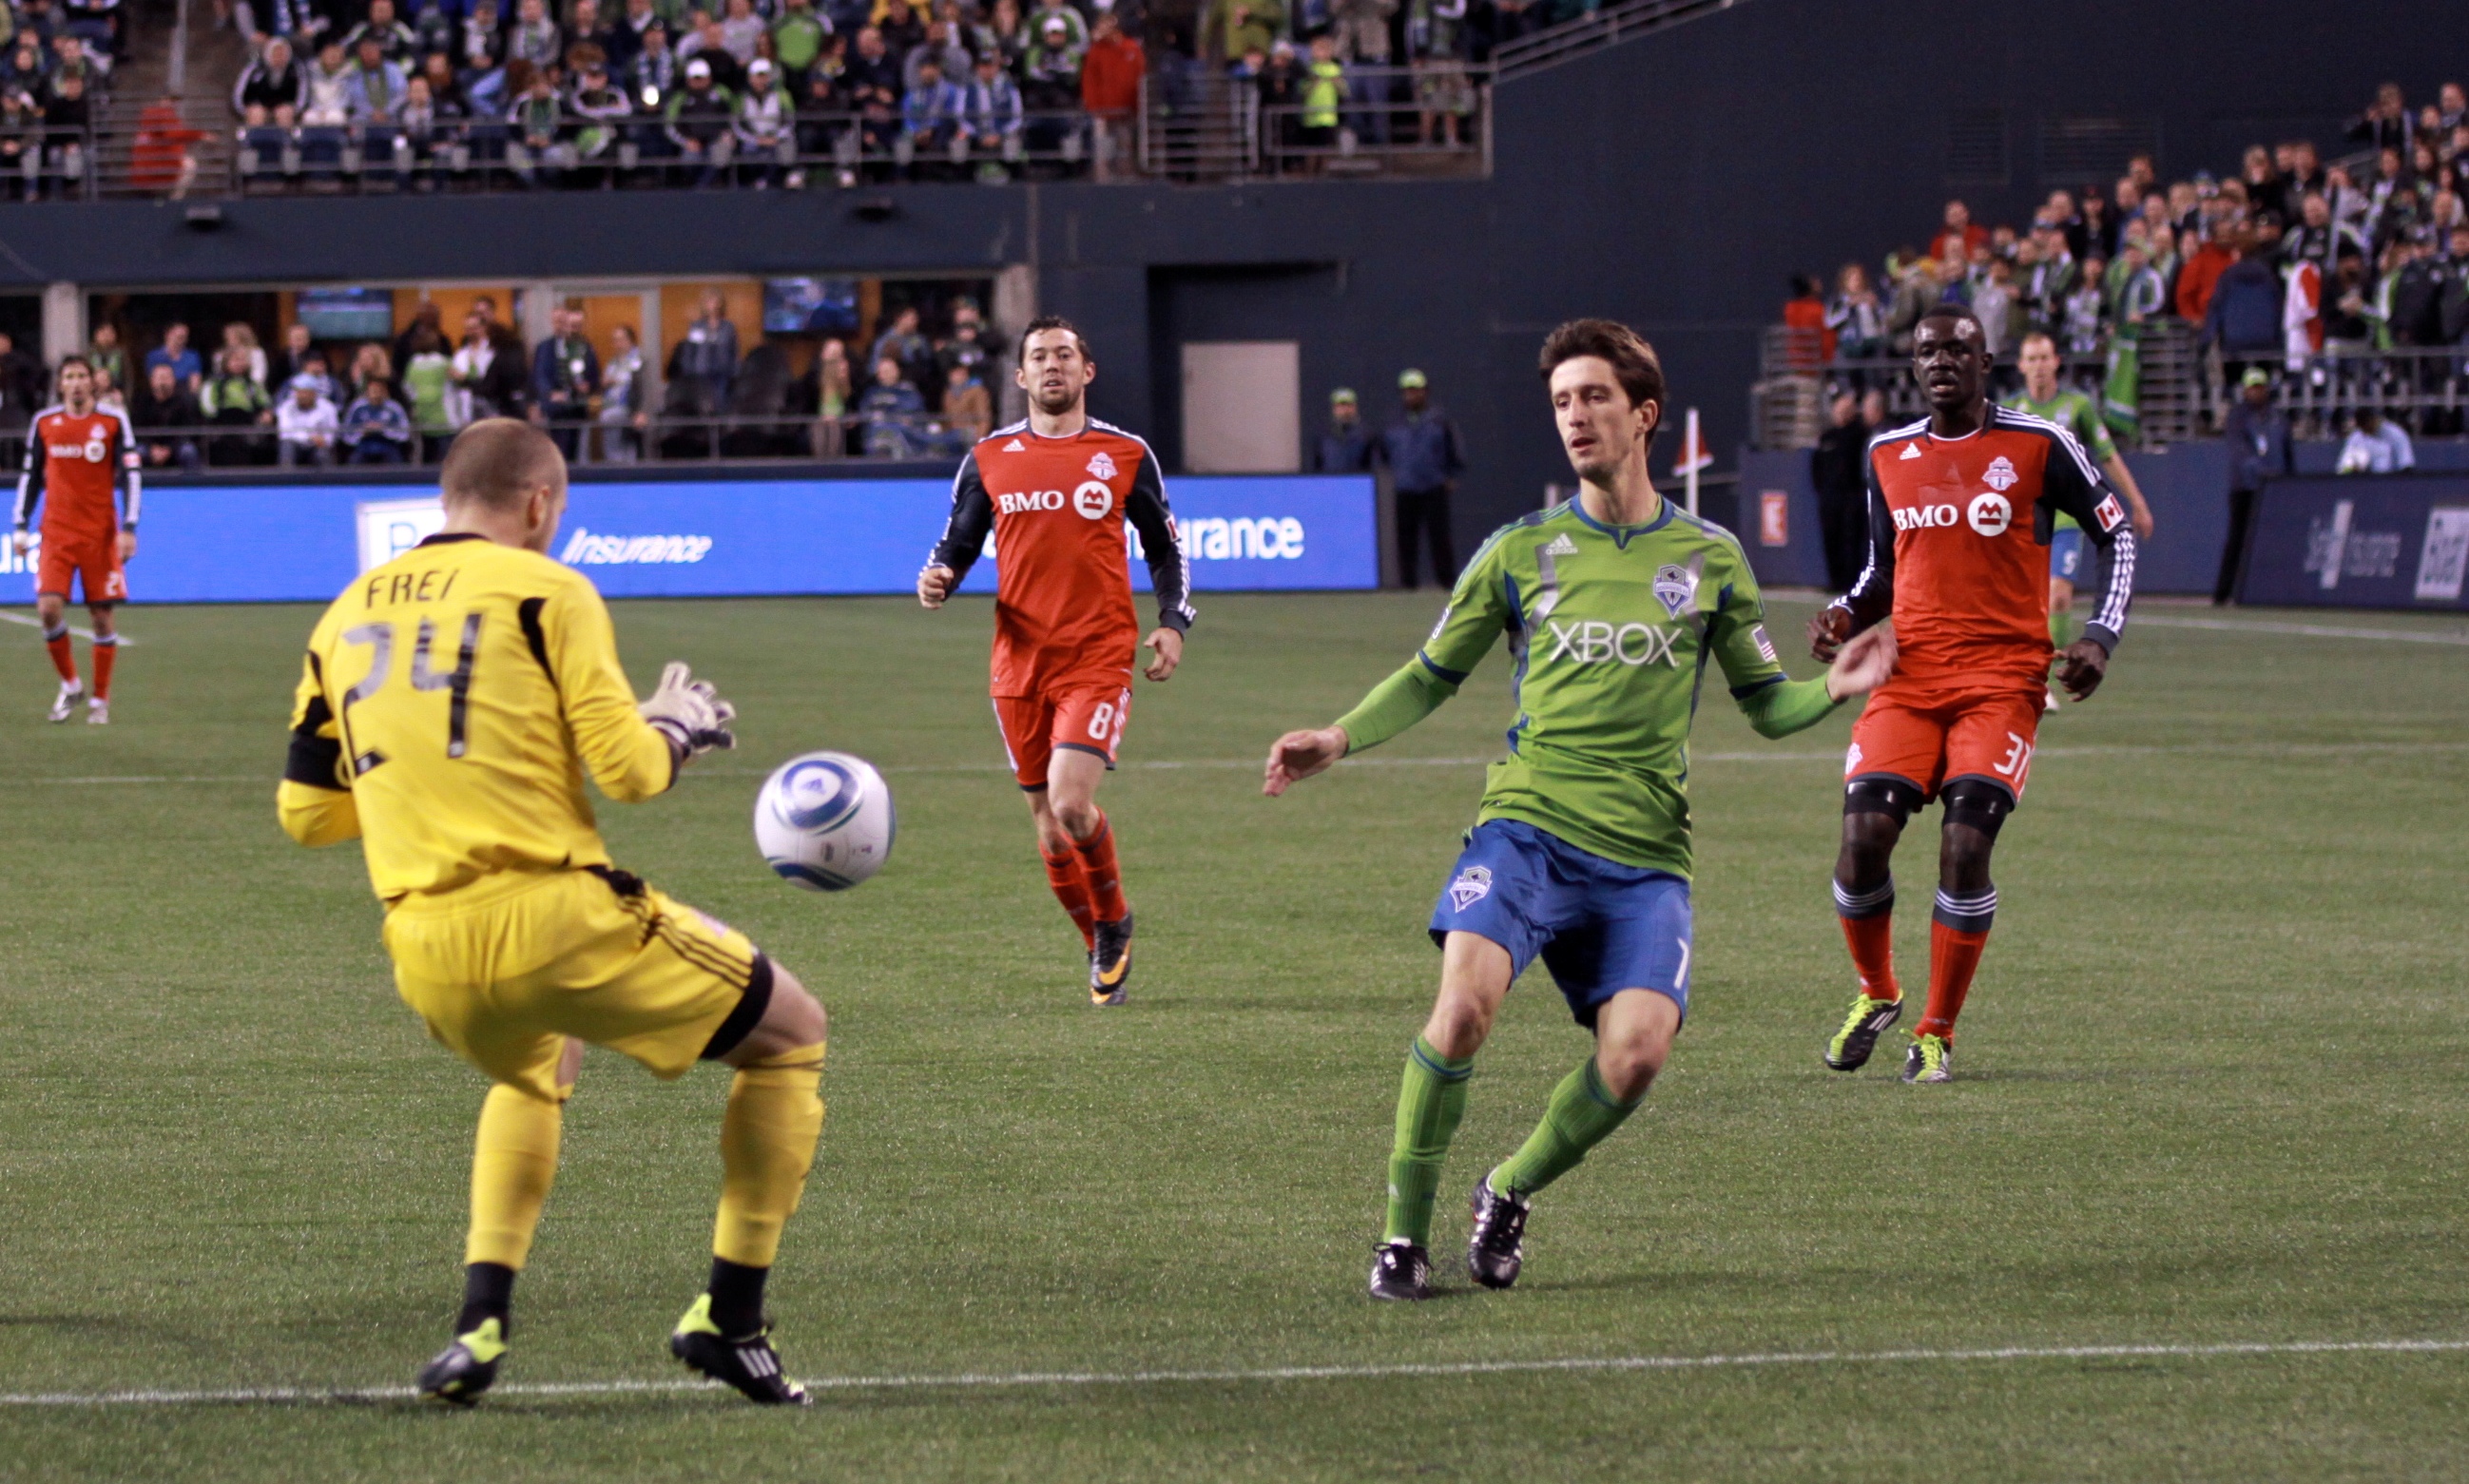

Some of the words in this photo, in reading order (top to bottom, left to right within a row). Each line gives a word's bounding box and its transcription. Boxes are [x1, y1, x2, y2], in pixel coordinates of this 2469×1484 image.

[998, 490, 1066, 515] BMO
[1892, 504, 1958, 530] BMO
[560, 526, 713, 564] Insurance
[366, 569, 460, 608] FREI
[1549, 620, 1683, 667] XBOX
[341, 612, 483, 777] 24
[1088, 702, 1114, 741] 8
[1993, 730, 2032, 783] 31
